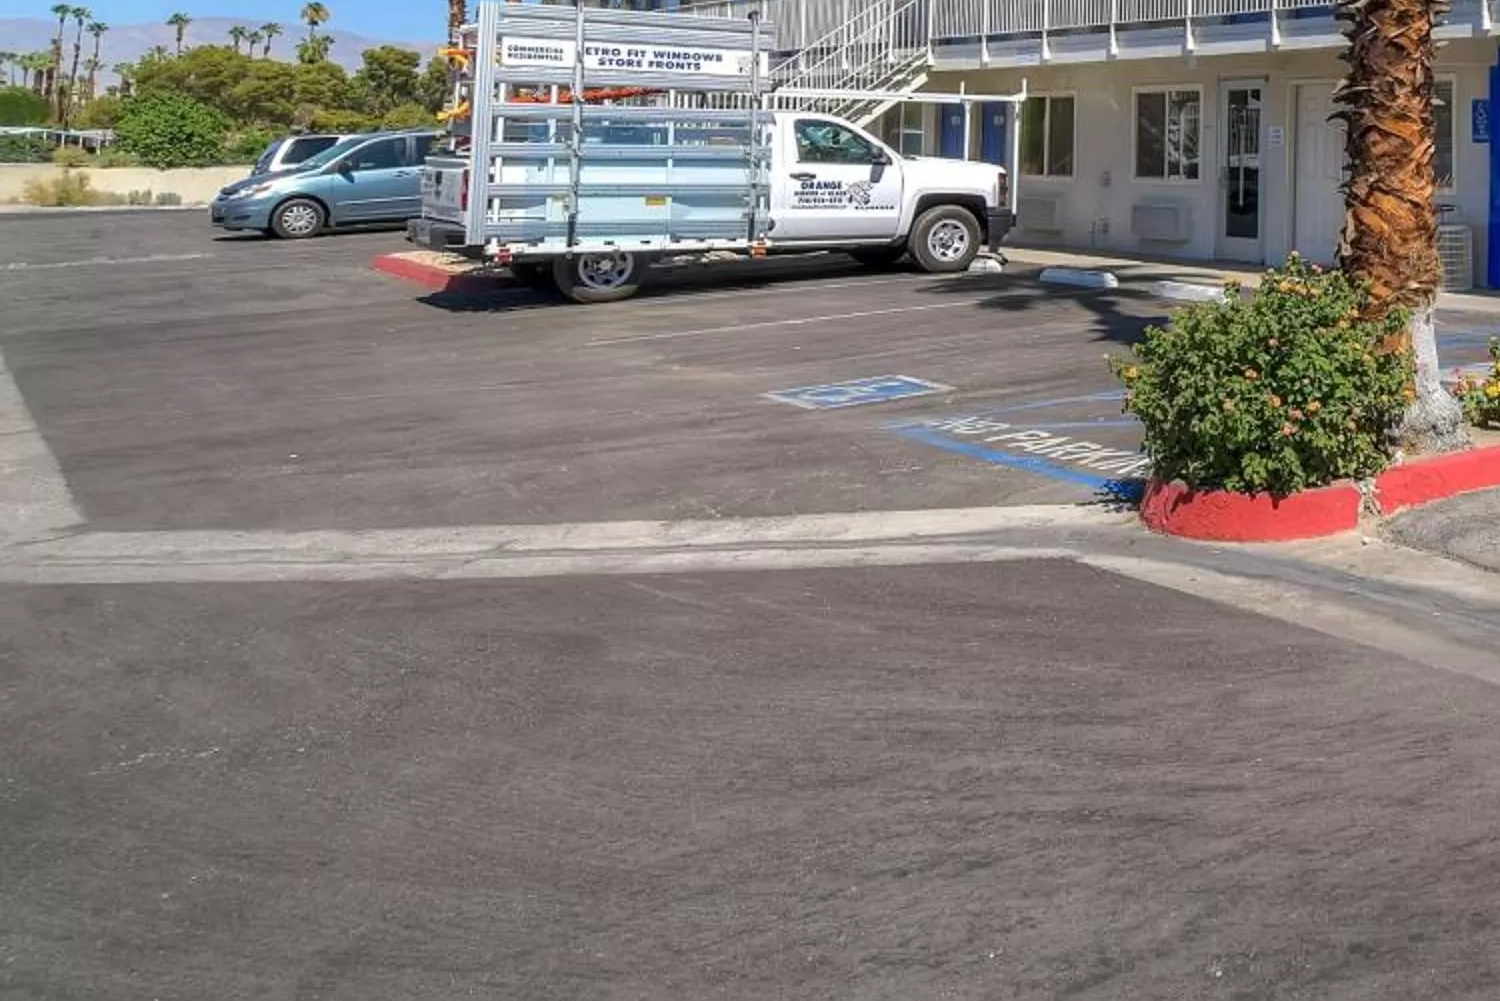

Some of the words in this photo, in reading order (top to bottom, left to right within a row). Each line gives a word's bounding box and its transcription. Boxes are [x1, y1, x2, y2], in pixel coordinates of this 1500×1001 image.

[584, 46, 621, 57] ETRO
[627, 49, 647, 58] FIT
[653, 50, 723, 63] WINDOWS
[598, 58, 643, 68] STORE
[648, 60, 701, 71] FRONTS
[800, 180, 842, 190] ORANGE
